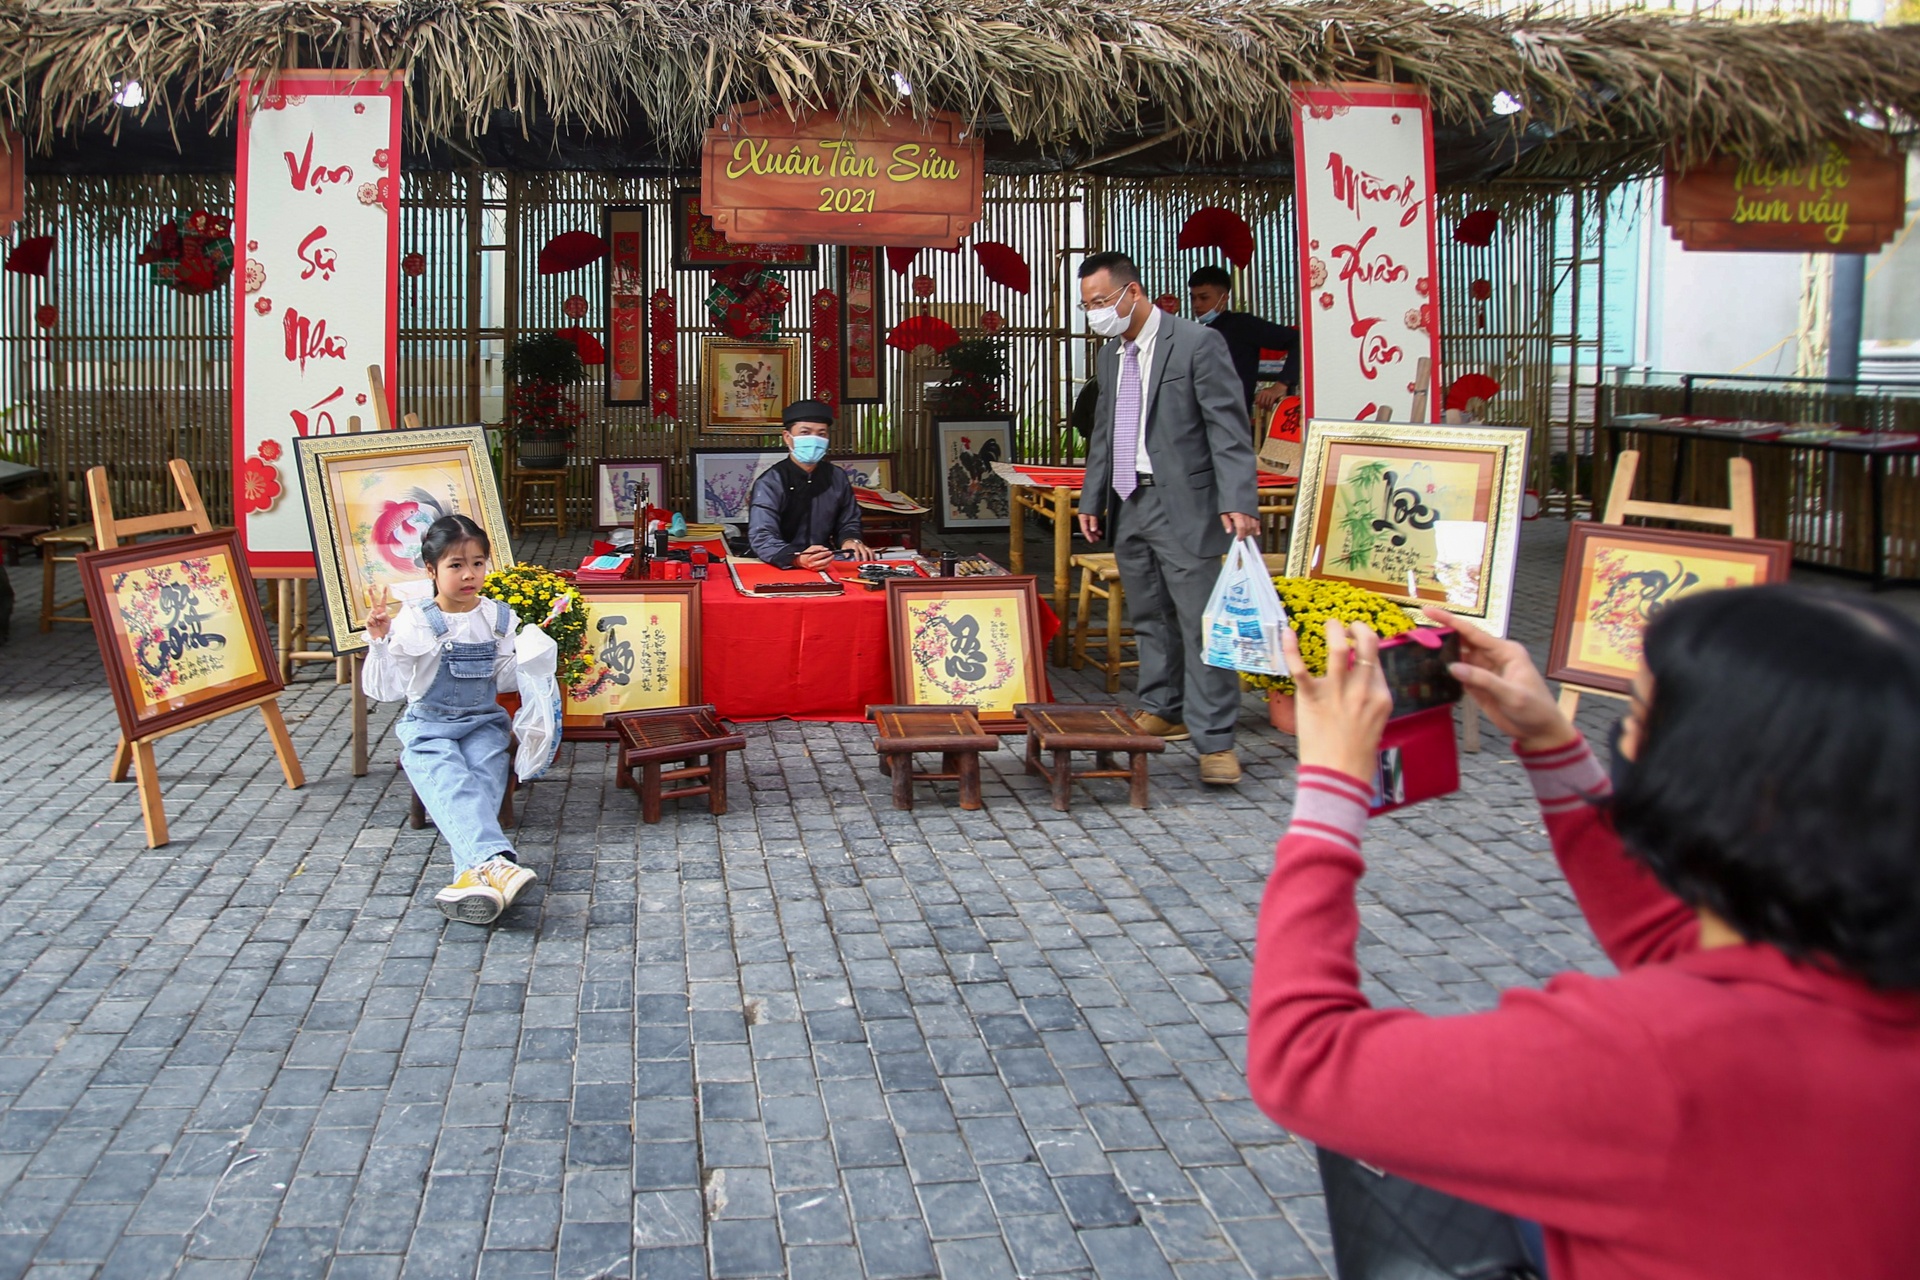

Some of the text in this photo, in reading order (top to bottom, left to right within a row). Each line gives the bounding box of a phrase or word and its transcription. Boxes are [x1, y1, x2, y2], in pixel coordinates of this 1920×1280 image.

[284, 129, 353, 194] Vạn
[726, 138, 824, 179] Xuân
[886, 143, 960, 182] Sửu
[1326, 152, 1424, 227] Mừng
[817, 187, 876, 213] 2021
[1730, 195, 1794, 224] sum
[297, 225, 338, 281] Sự
[1331, 226, 1408, 296] Xuân
[283, 307, 348, 376] Như
[1351, 317, 1403, 380] Tân
